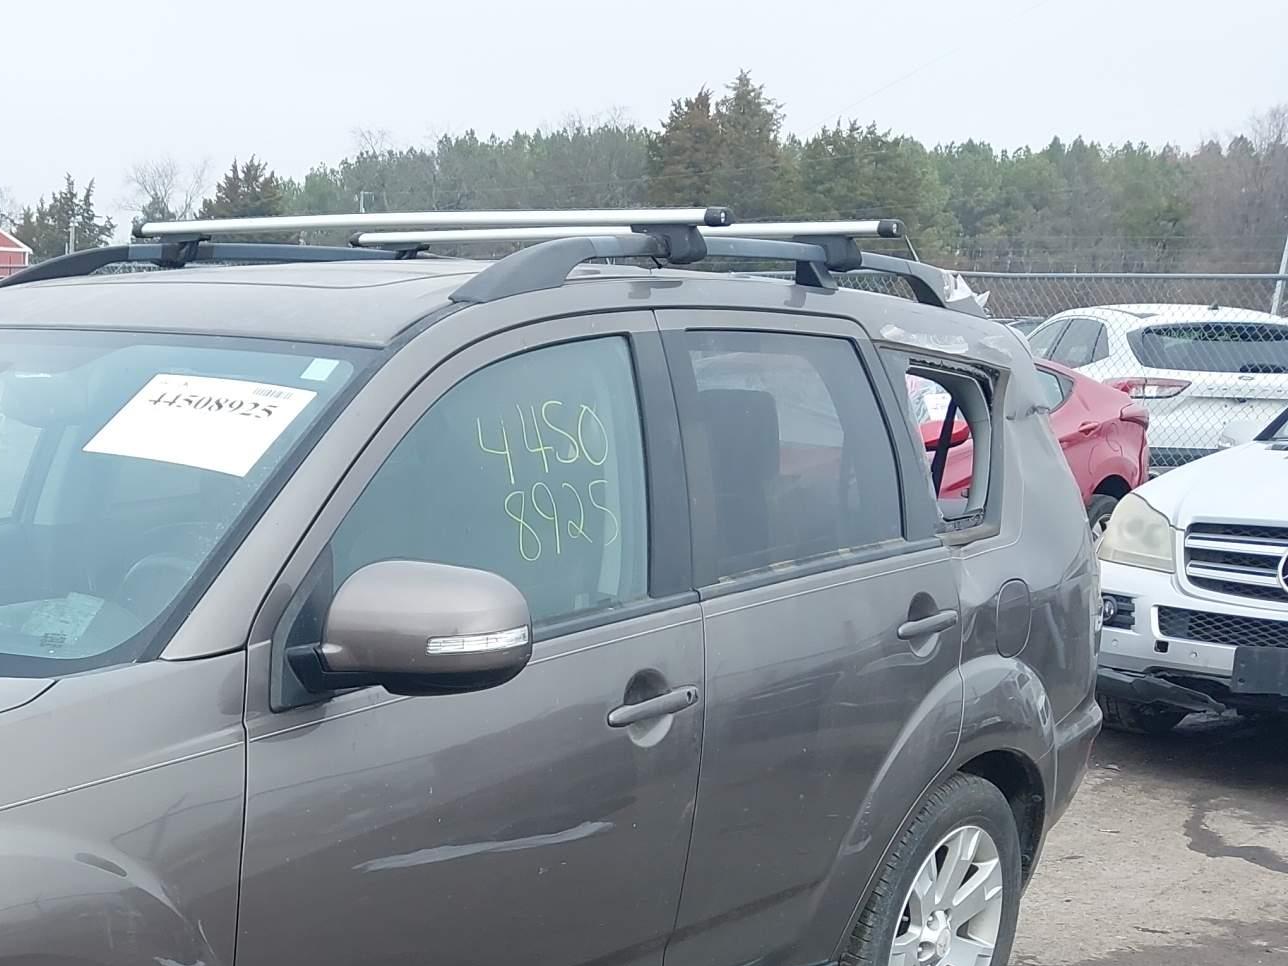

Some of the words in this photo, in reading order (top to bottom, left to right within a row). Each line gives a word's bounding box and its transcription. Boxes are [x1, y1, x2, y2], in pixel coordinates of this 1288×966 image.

[148, 392, 281, 418] 44508925
[476, 400, 609, 485] 4450
[504, 479, 619, 561] 8925
